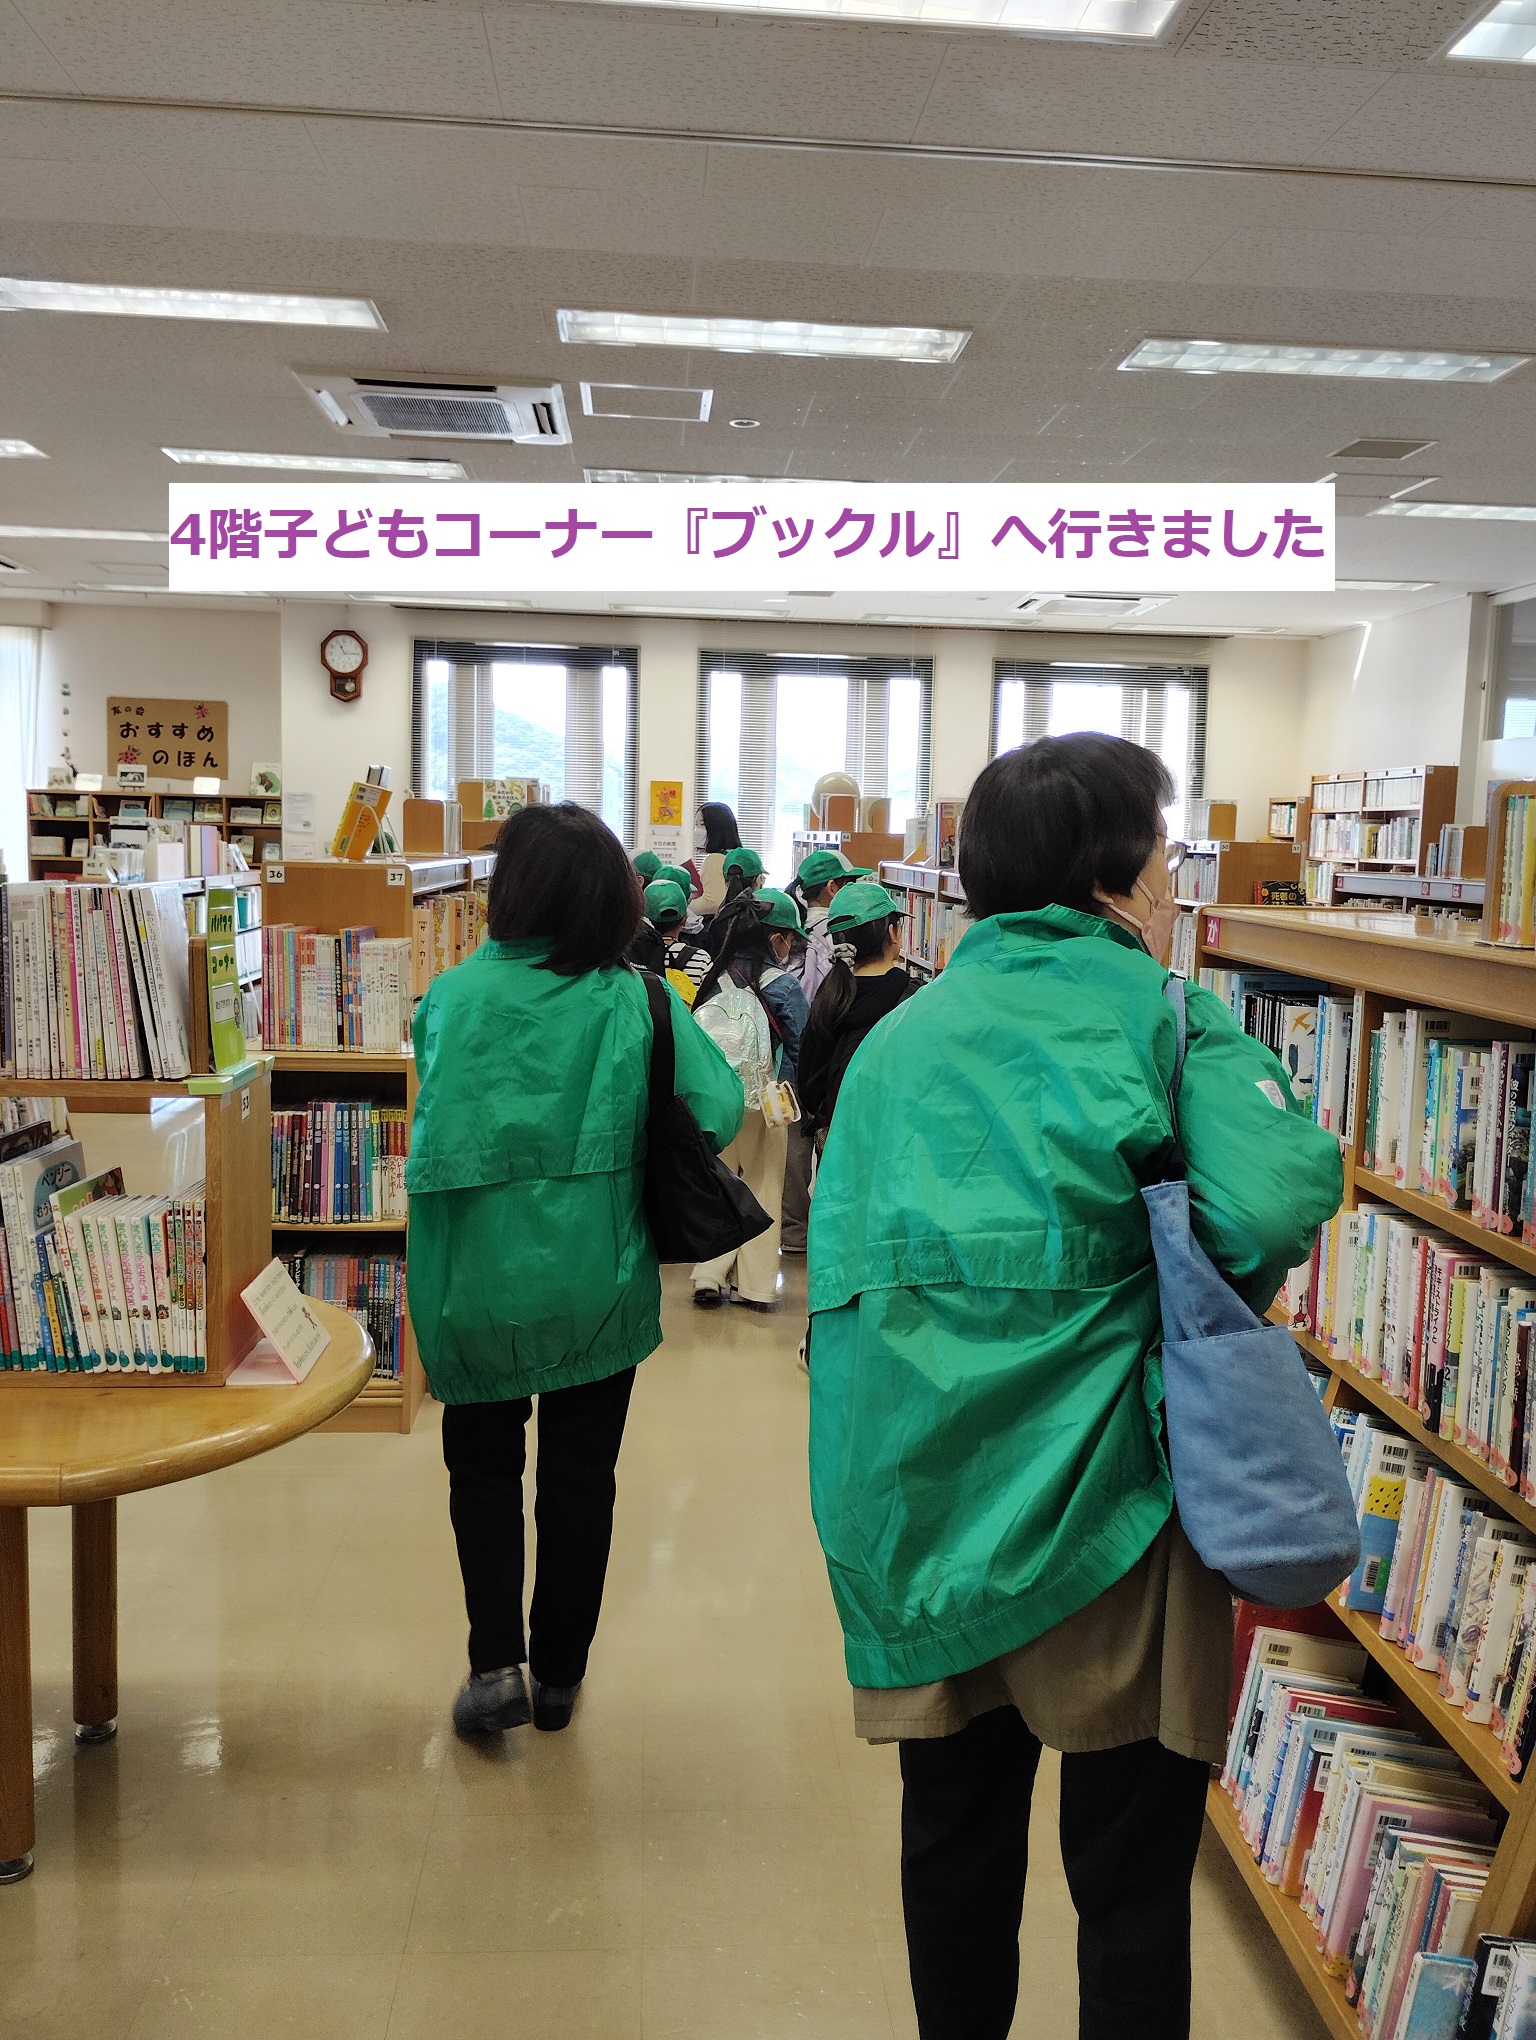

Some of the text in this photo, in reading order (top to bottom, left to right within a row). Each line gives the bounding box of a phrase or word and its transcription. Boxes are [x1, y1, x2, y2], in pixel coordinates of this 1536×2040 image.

[120, 721, 215, 742] おすすめ
[152, 749, 219, 768] のほん
[269, 871, 283, 879] 36
[390, 873, 403, 882] 37
[1271, 891, 1297, 901] 死者の
[1207, 920, 1218, 943] か
[1506, 1078, 1520, 1167] 彼の名はウォルター
[388, 1155, 397, 1198] バスケットボール
[395, 1155, 405, 1189] バレーボール
[1431, 1266, 1442, 1345] キキ・ストライクと
